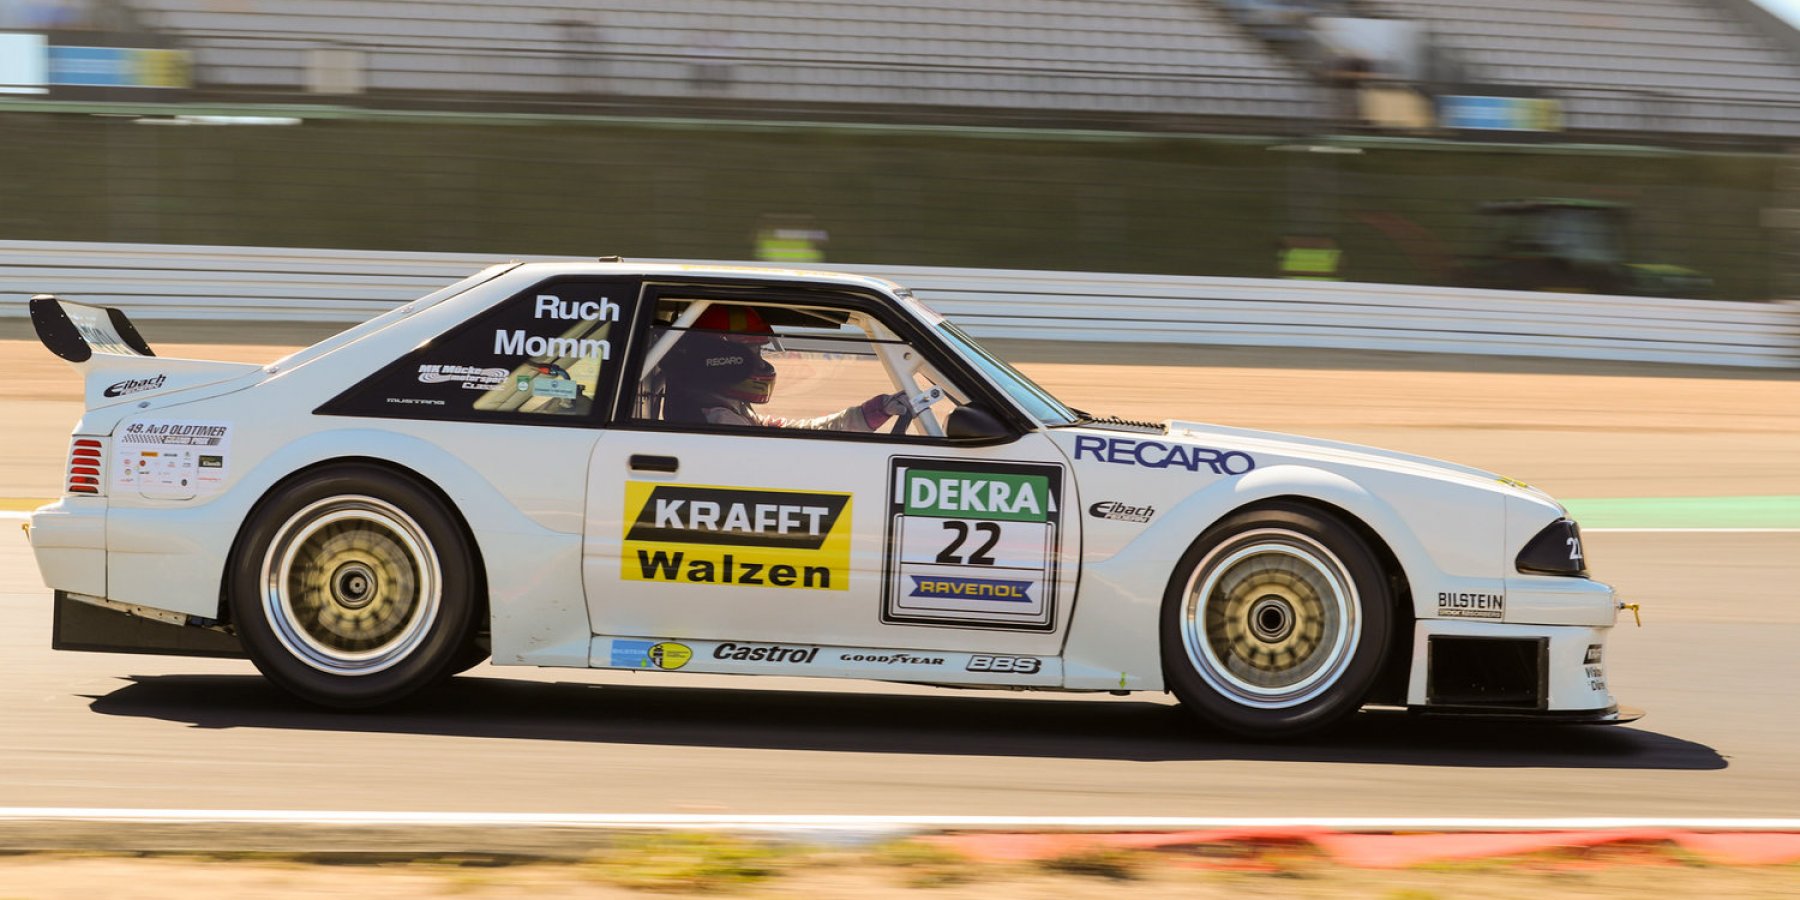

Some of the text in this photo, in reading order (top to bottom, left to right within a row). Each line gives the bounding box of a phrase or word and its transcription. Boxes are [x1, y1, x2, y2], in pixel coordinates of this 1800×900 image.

[534, 294, 620, 321] Ruch
[494, 329, 611, 360] Momm
[706, 356, 744, 368] RECARO
[103, 373, 167, 398] Eibach
[126, 423, 145, 434] 49.
[169, 425, 227, 437] OLDTIMER
[1074, 435, 1256, 476] RECARO
[910, 477, 1041, 515] DEKRA
[655, 498, 829, 536] KRAFFT
[1088, 500, 1156, 519] Eibach
[935, 520, 1002, 566] 22
[637, 550, 831, 588] Walzen
[919, 581, 1024, 598] RAVENOL
[1438, 592, 1503, 609] BILSTEIN
[713, 642, 820, 664] Castrol
[840, 653, 945, 665] GOODYEAR
[966, 654, 1042, 675] BBS
